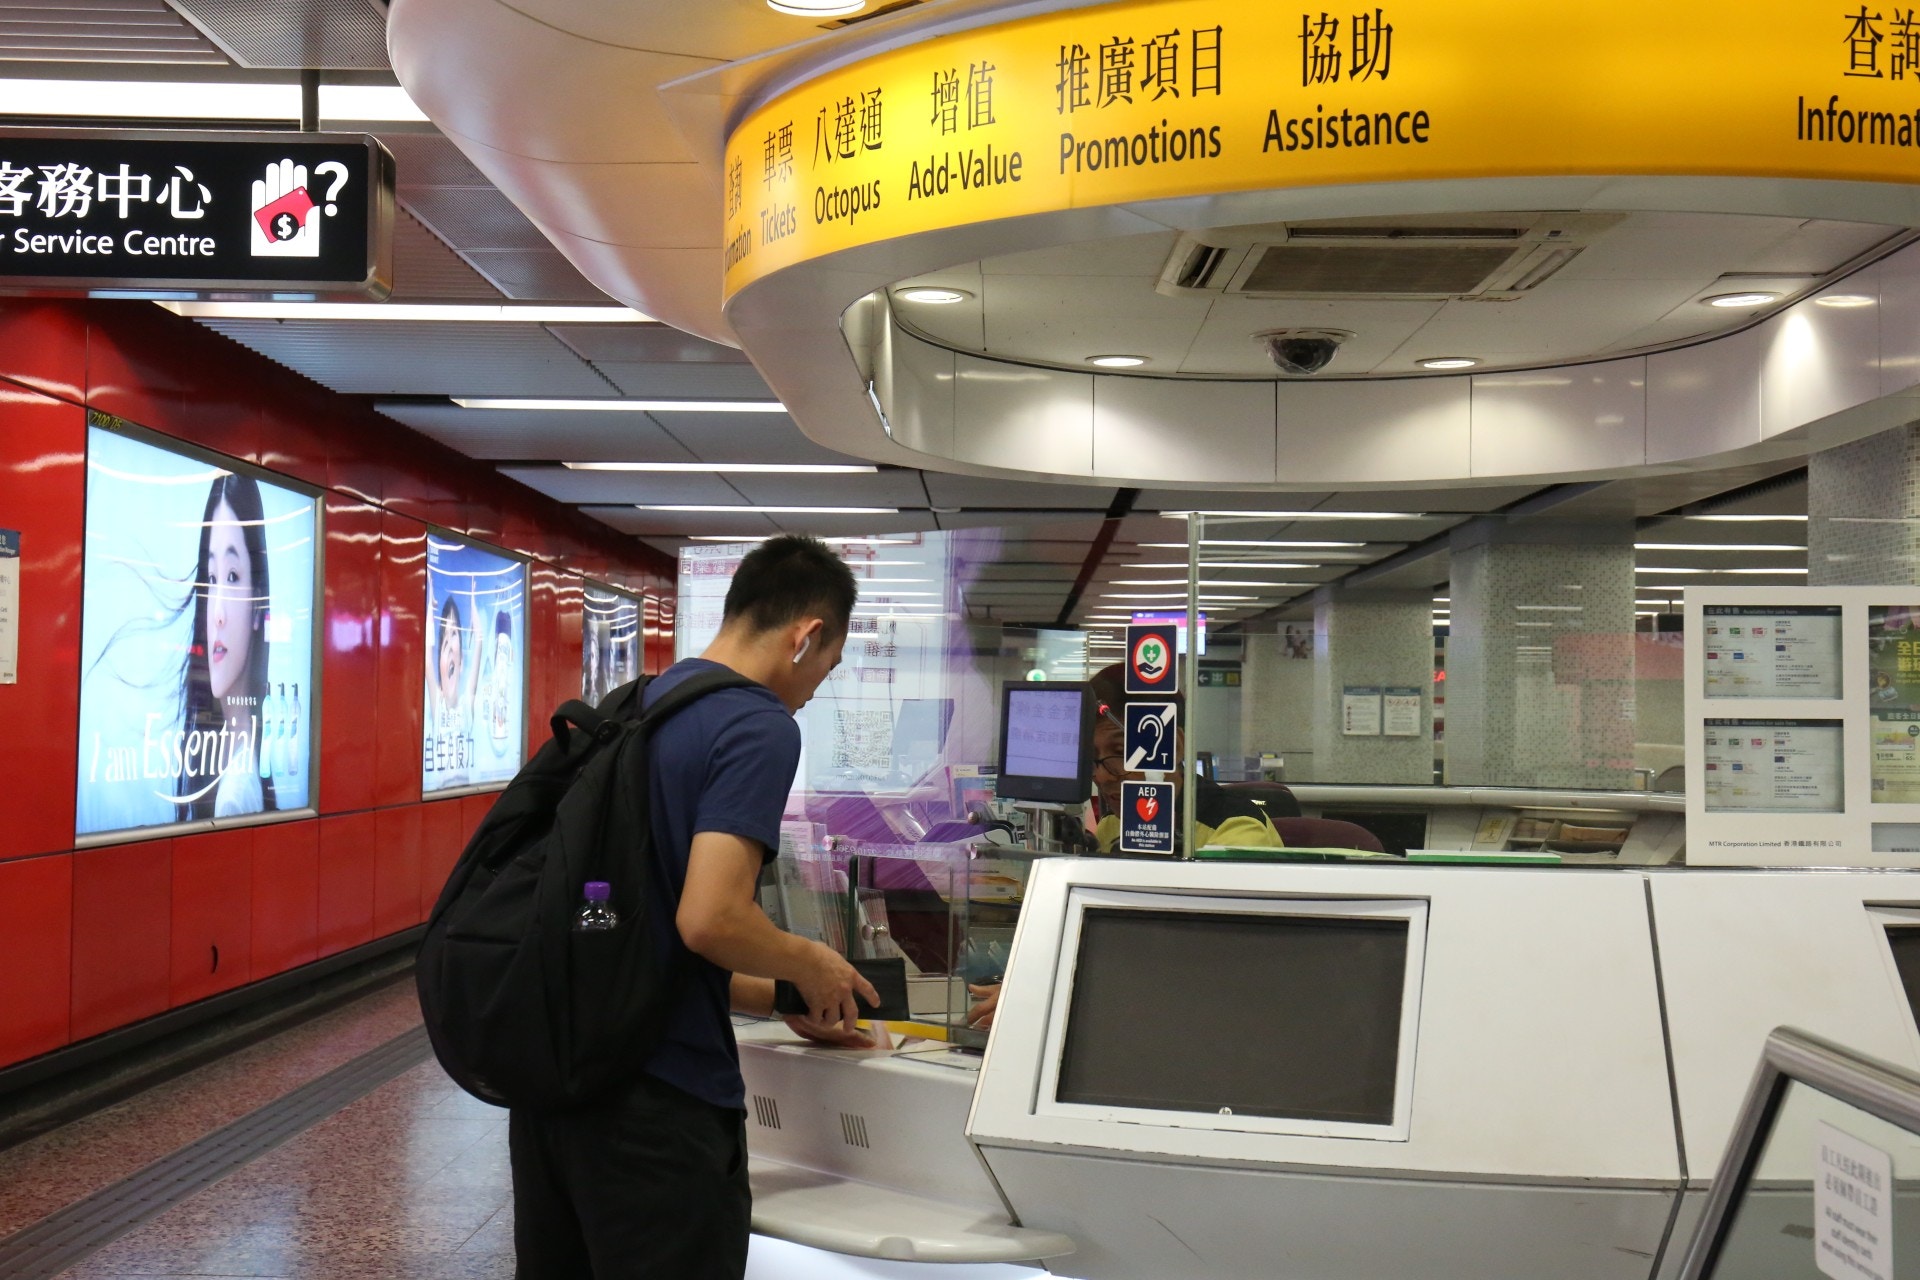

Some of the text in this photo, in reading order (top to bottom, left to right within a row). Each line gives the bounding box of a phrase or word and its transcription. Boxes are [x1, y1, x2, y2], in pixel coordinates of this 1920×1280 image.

[1055, 24, 1223, 115] 推廣項目
[1297, 8, 1393, 87] 協助
[930, 61, 996, 136] 增值
[763, 120, 794, 191] 車票
[812, 87, 883, 171] 八達通
[1060, 119, 1221, 175] Promotions
[1262, 104, 1430, 153] Assistance
[0, 161, 213, 219] 客務中心
[908, 144, 1022, 200] Add-Value
[761, 203, 796, 246] Tickets
[814, 179, 881, 225] Octopus
[14, 228, 114, 255] Service
[124, 229, 215, 256] Centre
[104, 744, 137, 782] am
[143, 712, 257, 779] Essential
[1161, 752, 1168, 765] T
[1138, 787, 1157, 797] AED
